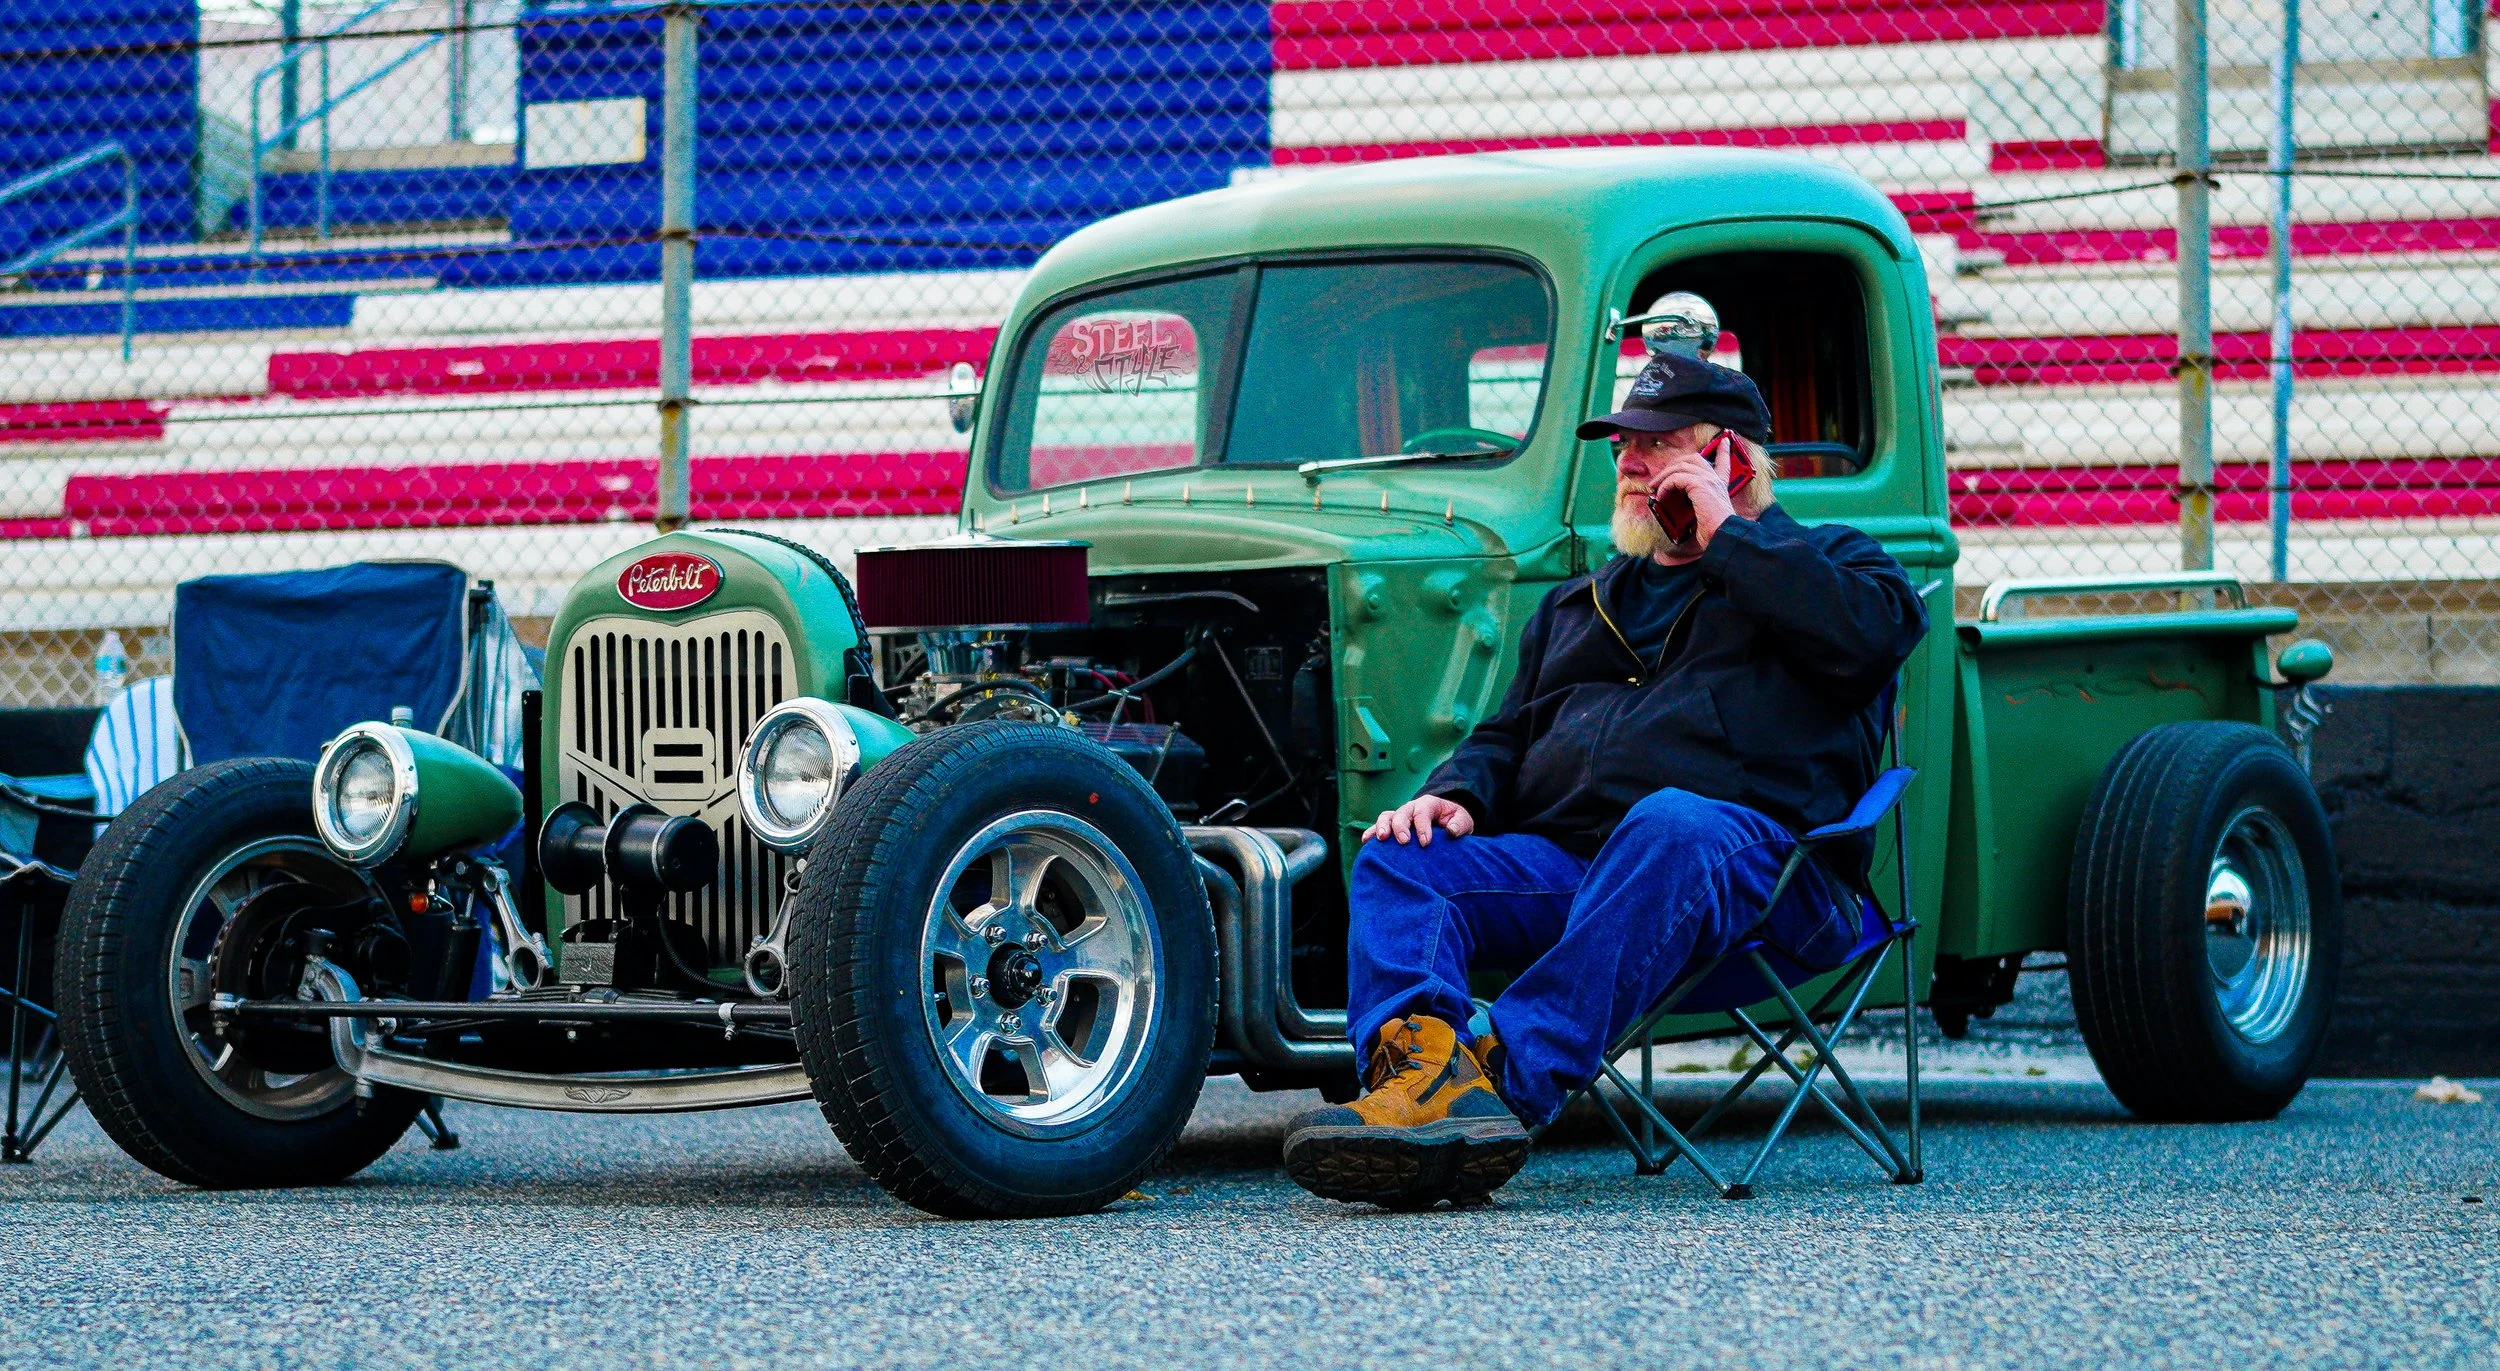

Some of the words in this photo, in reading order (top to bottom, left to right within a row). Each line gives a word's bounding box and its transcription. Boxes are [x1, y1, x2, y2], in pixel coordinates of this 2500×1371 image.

[1071, 319, 1173, 359] STEEL
[1093, 343, 1182, 398] STYLE
[627, 563, 711, 597] Peterbilt
